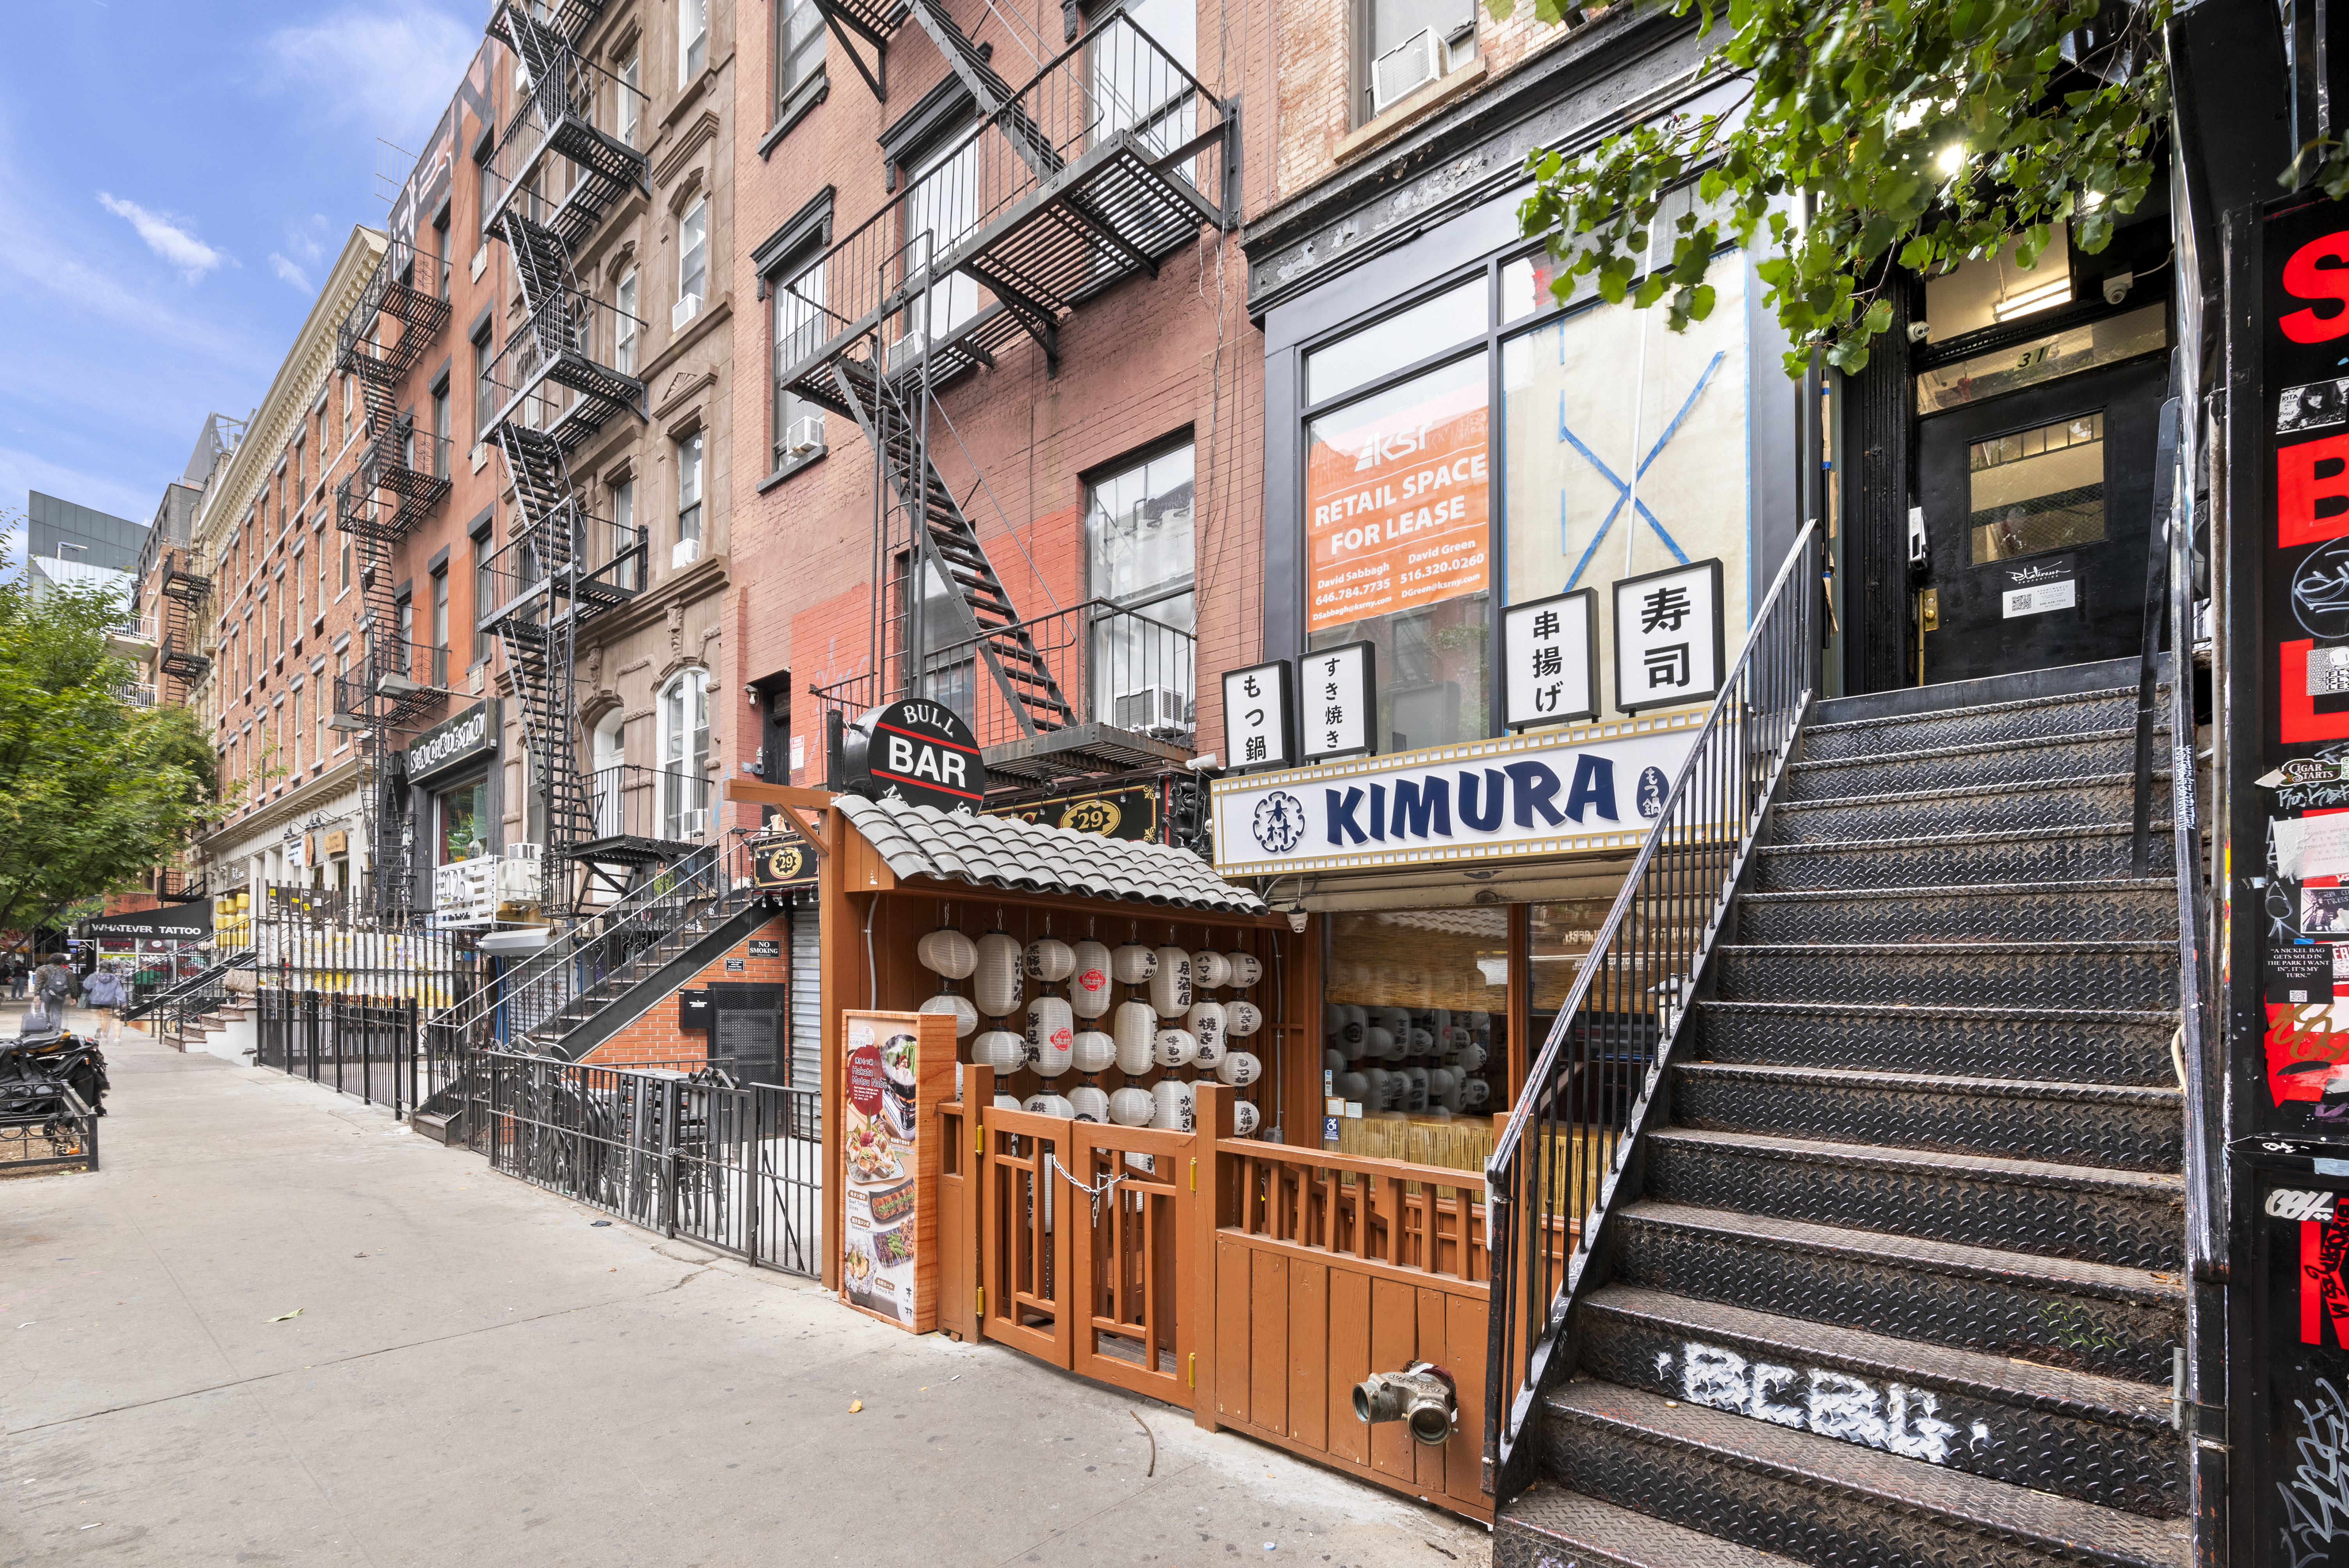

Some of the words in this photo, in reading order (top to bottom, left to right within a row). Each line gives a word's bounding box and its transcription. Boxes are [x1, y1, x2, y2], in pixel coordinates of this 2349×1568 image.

[2018, 347, 2045, 367] 31
[1315, 485, 1396, 527] RETAIL
[1403, 453, 1487, 499] SPACE
[1331, 524, 1380, 555] FOR
[1387, 495, 1465, 540] LEASE
[1408, 547, 1439, 564] David
[1441, 539, 1476, 555] Green
[1318, 572, 1344, 589] David
[1346, 562, 1390, 582] Sabbagh
[1400, 553, 1484, 584] 516.320.0260
[2018, 575, 2058, 584] PROPERTIES
[1315, 579, 1390, 606] 646.784.7735
[1401, 573, 1480, 598] DGreen@ksrny.com
[1313, 595, 1392, 621] DSabbagh@ksrny.com
[1641, 586, 1691, 689] 寿司
[1533, 610, 1564, 712] 串揚げ
[1324, 658, 1343, 749] すき焼き
[904, 704, 954, 738] BULL
[1244, 674, 1266, 761] もつ鍋
[889, 735, 966, 788] BAR
[2288, 764, 2322, 773] CIGAR
[2292, 771, 2333, 782] STARTS
[1326, 754, 1620, 846] KIMURA
[1078, 812, 1104, 828] 29
[779, 854, 793, 870] 29
[2323, 896, 2349, 905] TREES
[91, 923, 153, 933] WHATEVER
[159, 926, 201, 935] TATTOO
[1197, 956, 1211, 983] ハマチ
[1177, 961, 1191, 1006] 居酒屋
[1164, 1035, 1181, 1064] 牛もつ
[1197, 1017, 1217, 1060] 焼き鳥
[852, 1066, 873, 1076] Hakata
[852, 1075, 870, 1086] Motsu
[872, 1077, 887, 1089] Nabe
[1234, 1058, 1249, 1083] もつ鍋
[852, 1224, 865, 1232] Skewers
[876, 1285, 887, 1294] Kimura
